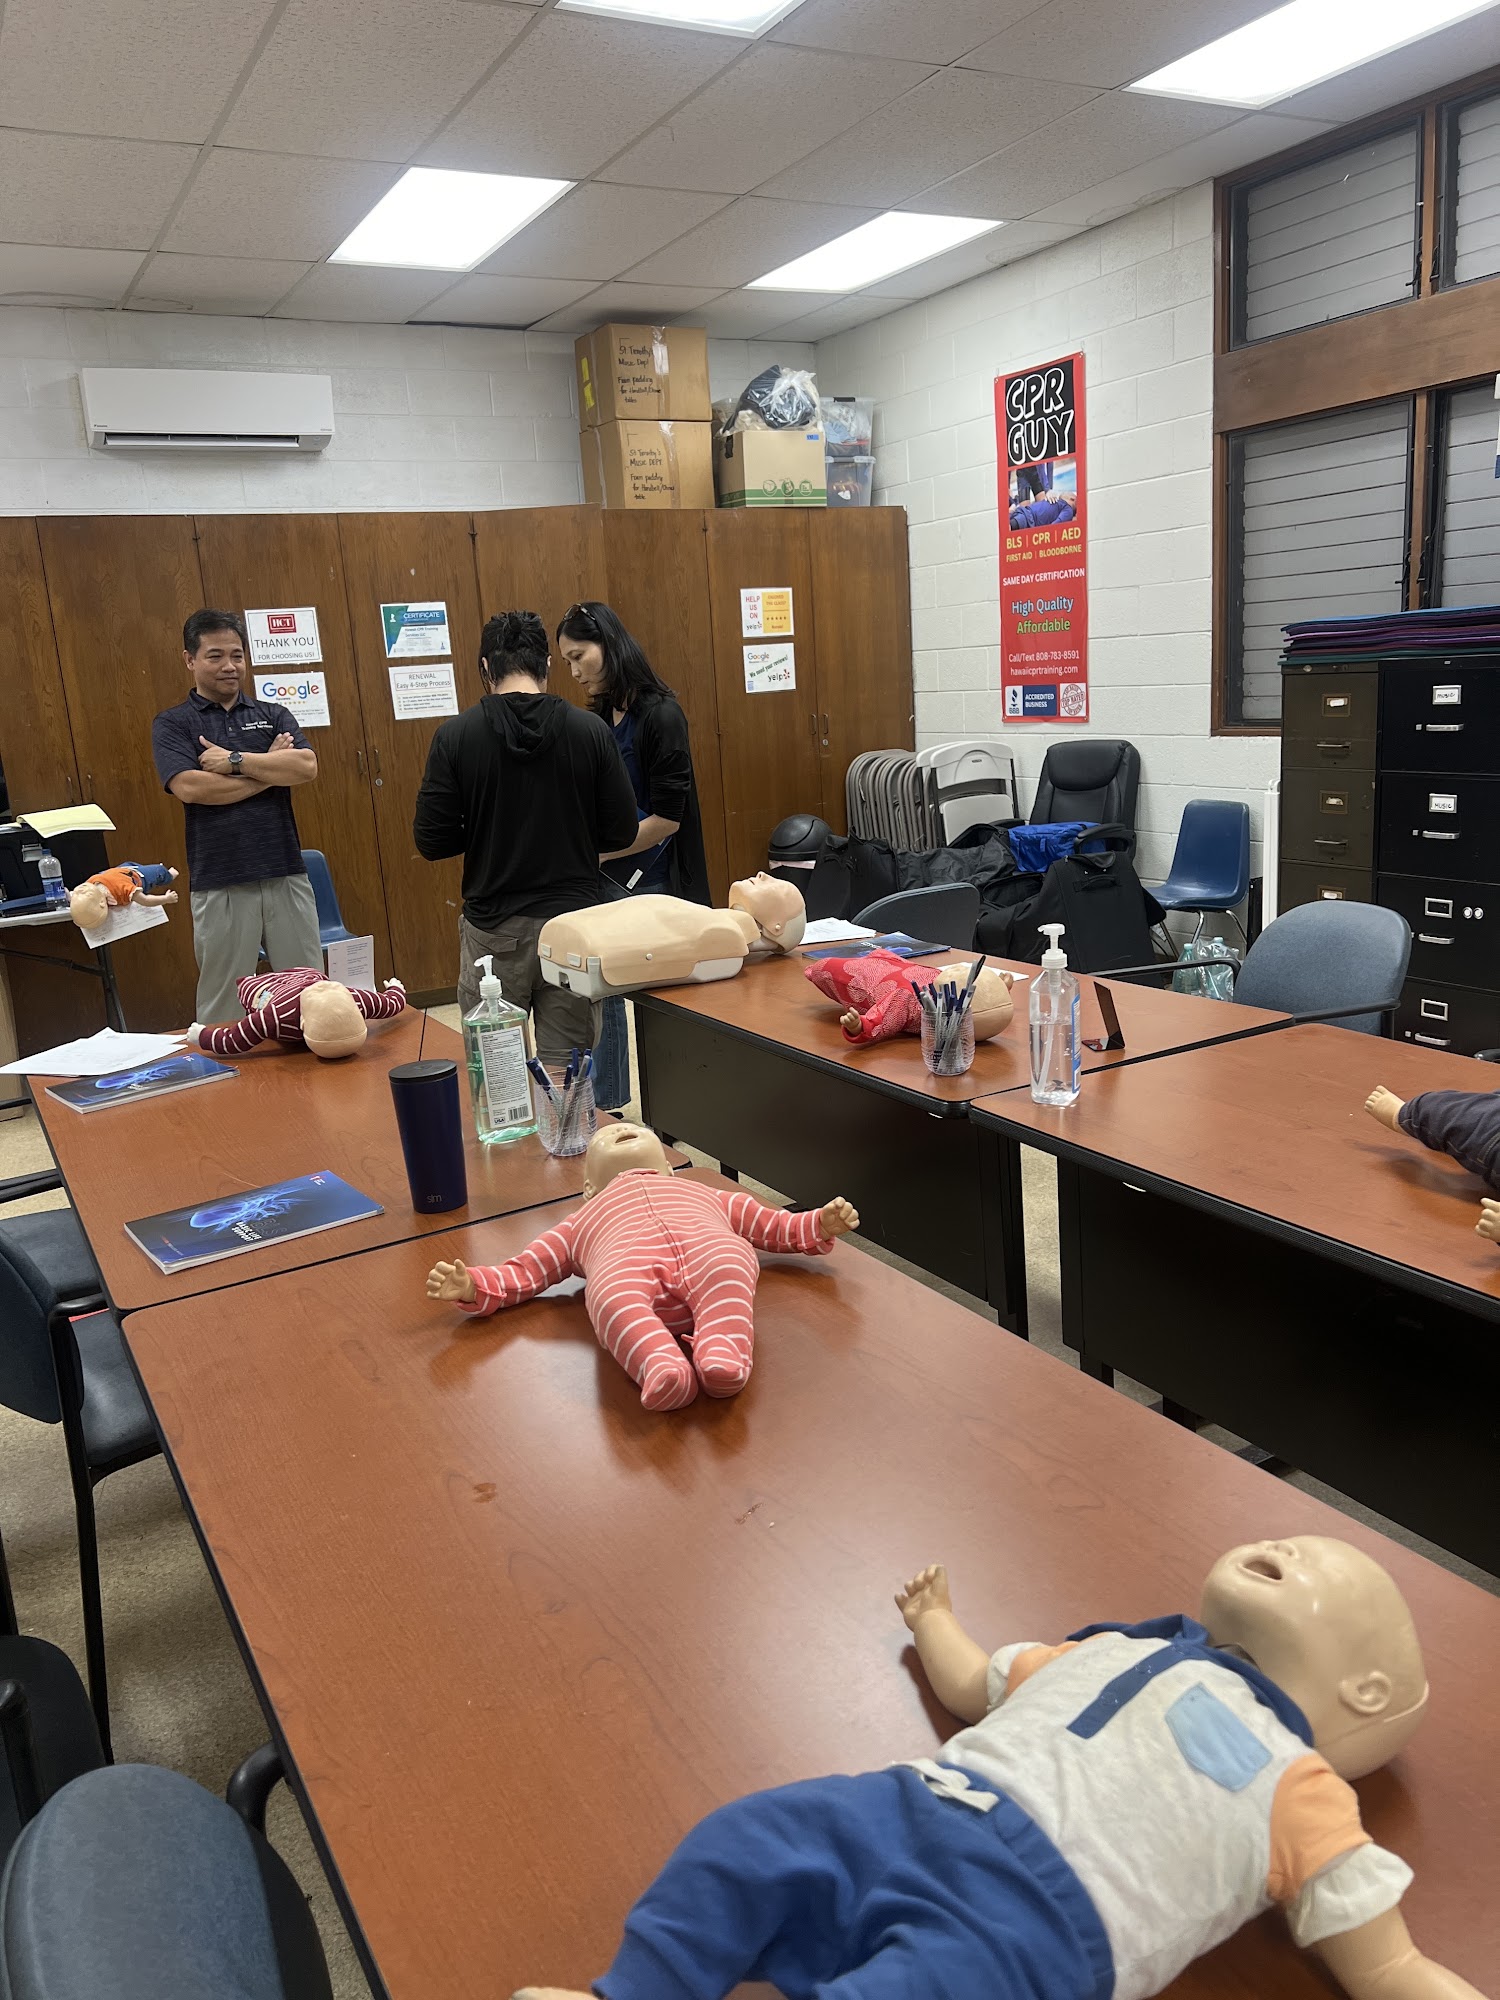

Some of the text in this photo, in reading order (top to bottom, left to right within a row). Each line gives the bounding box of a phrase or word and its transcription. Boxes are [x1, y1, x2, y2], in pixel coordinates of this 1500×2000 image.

[1006, 367, 1064, 421] CPR
[1008, 410, 1074, 465] GUY
[1006, 527, 1081, 549] BLS CPR AED
[1006, 544, 1082, 562] FIRST AID BLOODBORNE
[1002, 567, 1085, 586] SAME DAY CERTIFICATION
[1011, 596, 1074, 616] High Quality
[1017, 617, 1071, 634] Affordable
[254, 637, 314, 648] THANK YOU
[271, 652, 303, 660] CHOOSING
[747, 652, 769, 661] Google
[1008, 650, 1080, 663] Call/Text 808-783-8591
[408, 672, 436, 680] RENEWAL
[767, 673, 783, 683] yelp
[1010, 664, 1078, 677] hawaiicprtraining.com
[262, 680, 319, 699] Google
